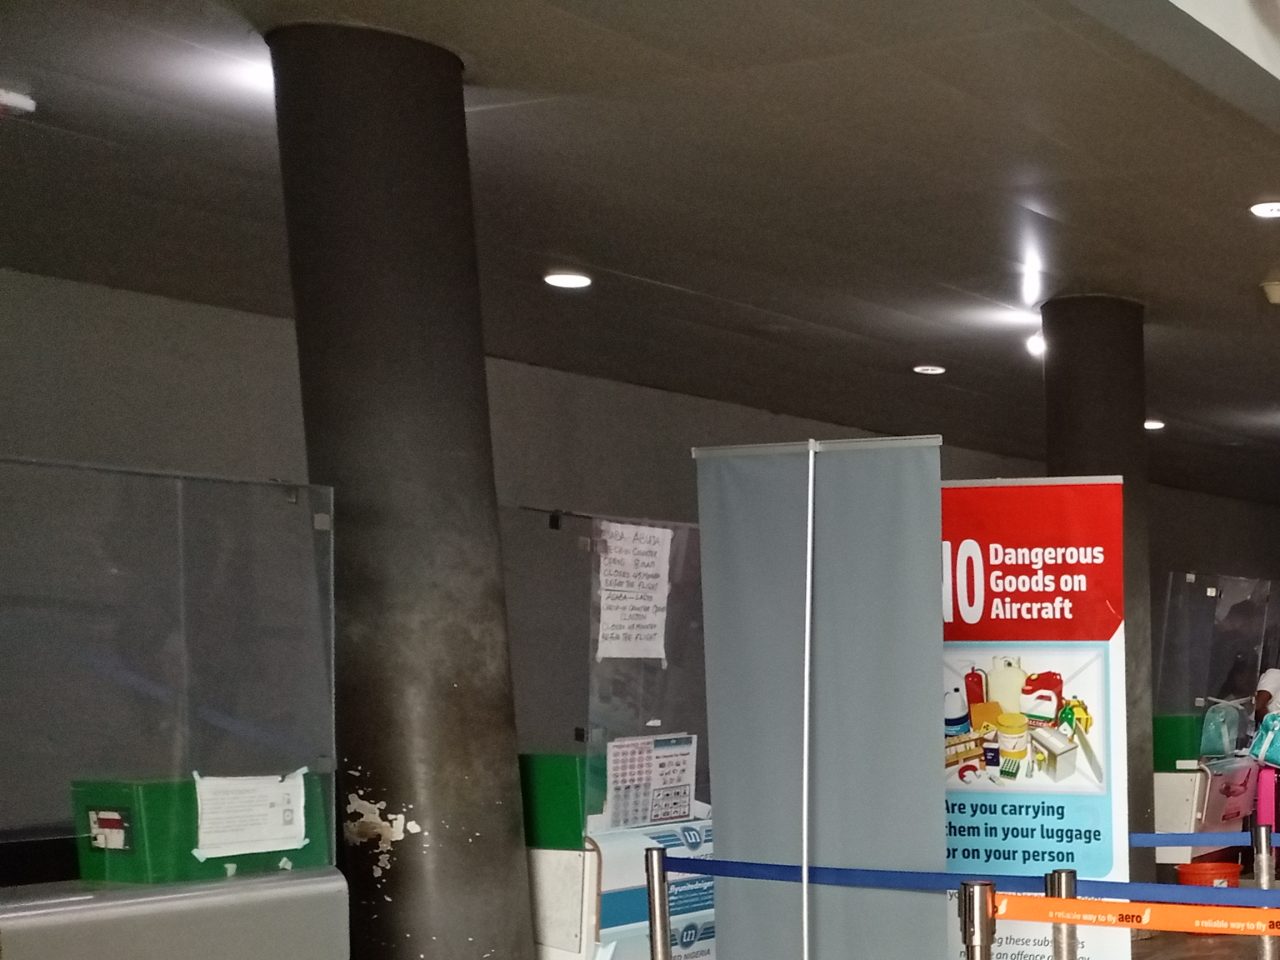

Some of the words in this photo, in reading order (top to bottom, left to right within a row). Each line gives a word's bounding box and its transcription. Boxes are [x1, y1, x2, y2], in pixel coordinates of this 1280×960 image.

[988, 543, 1105, 570] Dangerous
[989, 569, 1056, 593] Goods
[1059, 573, 1087, 592] on
[990, 596, 1073, 620] Aircraft
[970, 802, 997, 818] you
[1001, 801, 1065, 820] carrying
[944, 821, 981, 837] hem
[984, 822, 998, 837] in
[1001, 825, 1037, 841] your
[1040, 824, 1101, 844] luggage
[962, 847, 981, 859] on
[984, 848, 1019, 863] your
[1022, 849, 1075, 865] person
[1118, 912, 1142, 924] aero
[1229, 921, 1246, 932] way
[1246, 922, 1256, 930] to
[1256, 922, 1267, 932] fly
[1005, 935, 1031, 947] these
[995, 952, 1008, 960] an
